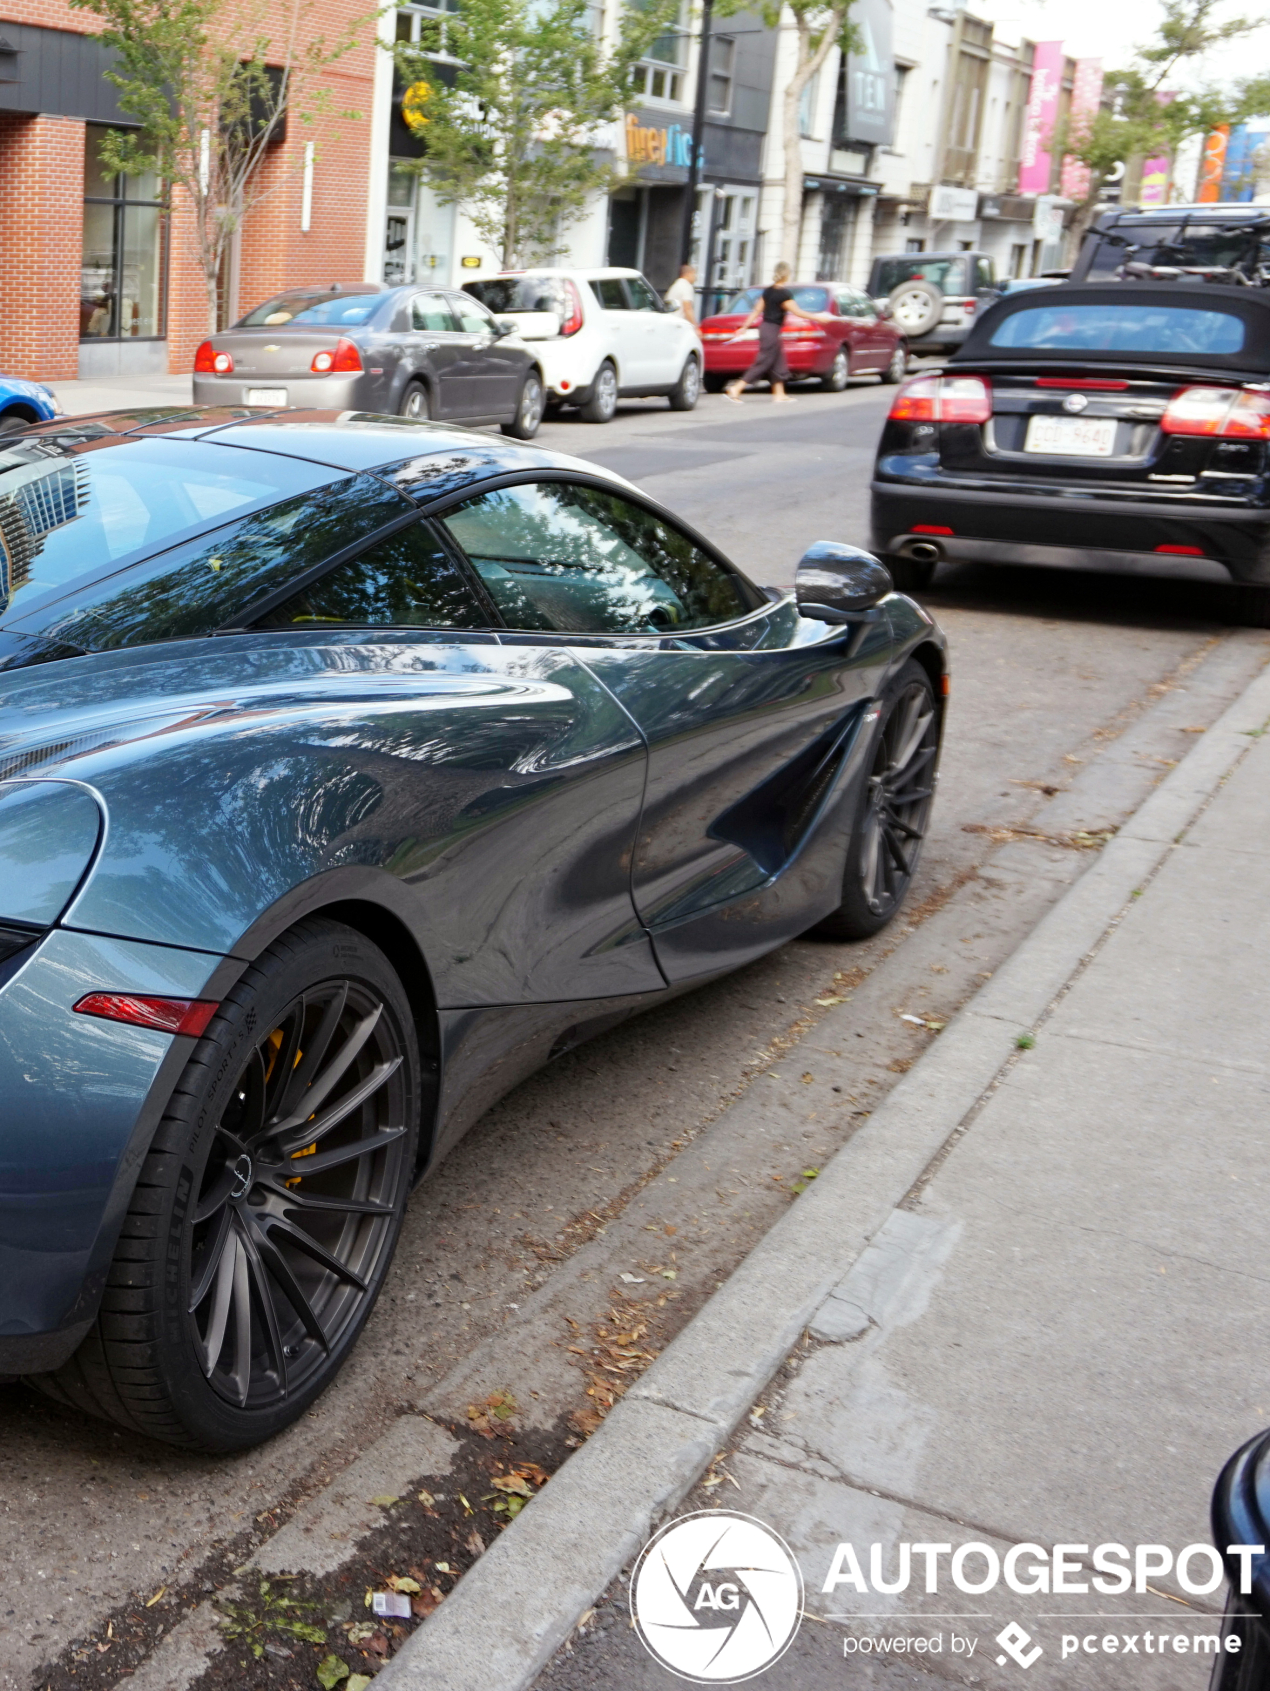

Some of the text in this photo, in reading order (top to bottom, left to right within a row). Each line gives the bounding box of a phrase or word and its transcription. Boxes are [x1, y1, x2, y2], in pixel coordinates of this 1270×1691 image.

[855, 71, 886, 111] TEN
[188, 1107, 209, 1155] PILOT
[207, 1051, 234, 1102] SPORT
[238, 1030, 245, 1041] S
[164, 1175, 191, 1346] MICHELIN
